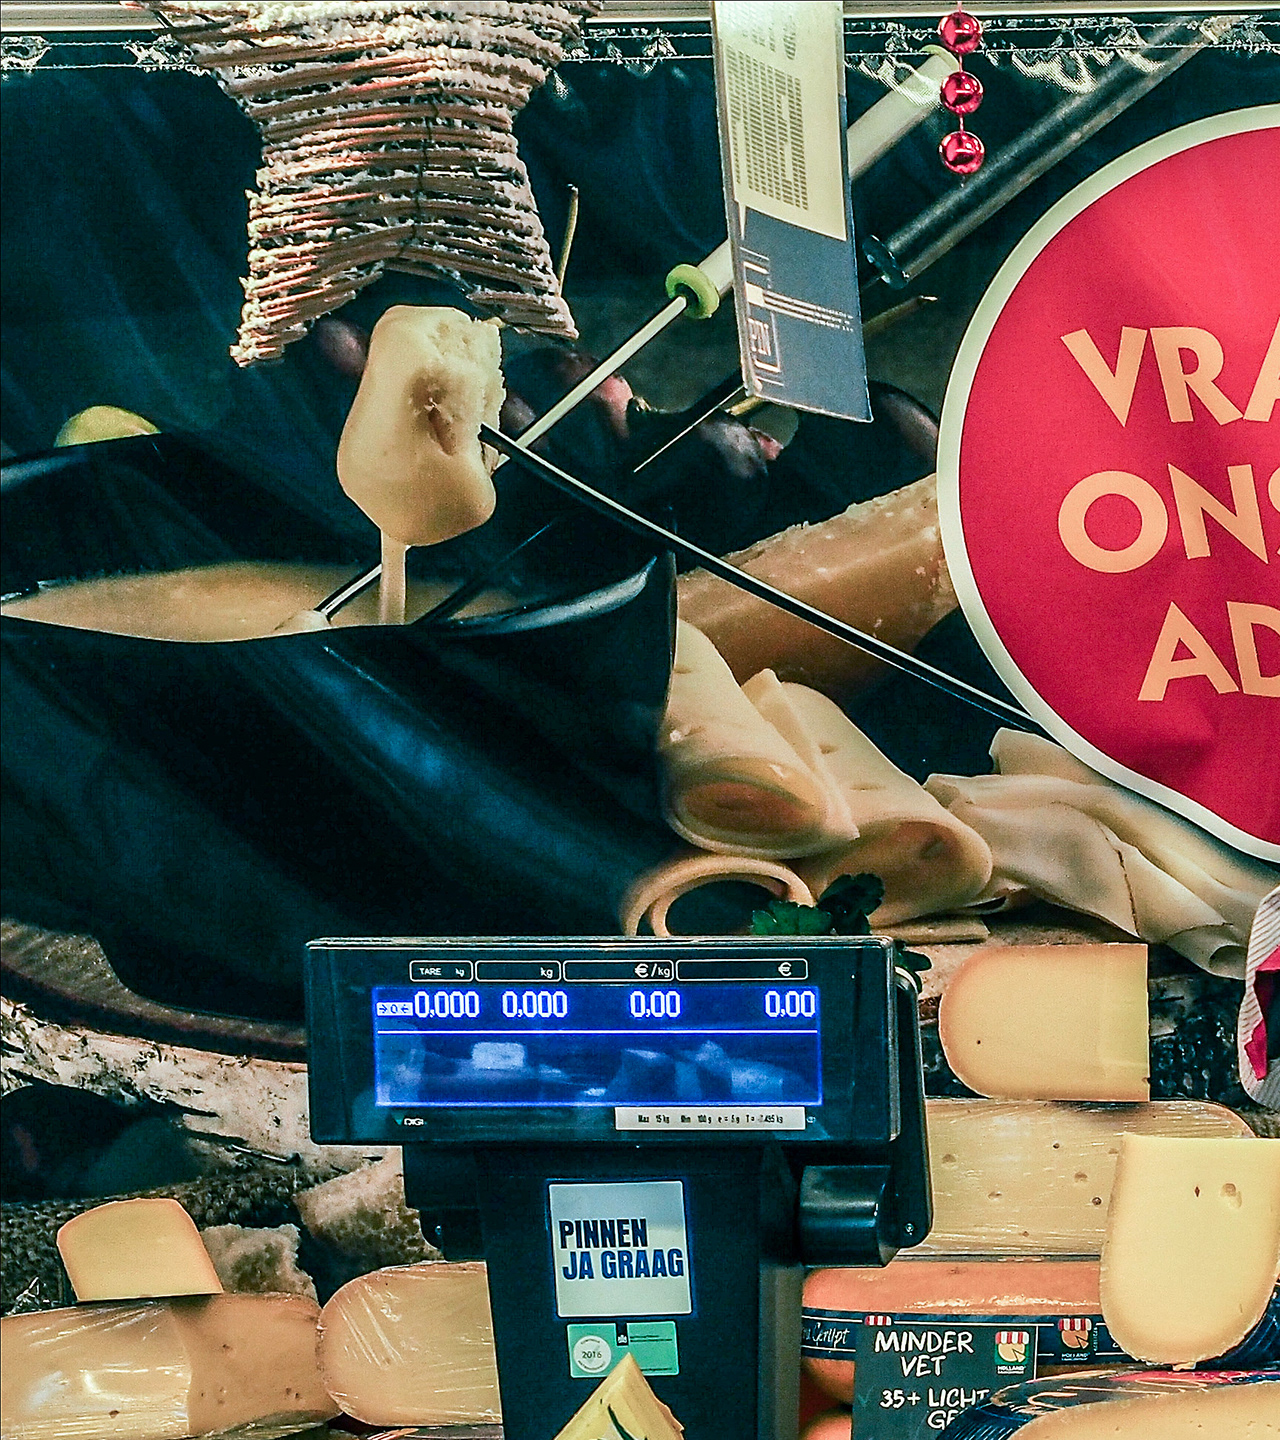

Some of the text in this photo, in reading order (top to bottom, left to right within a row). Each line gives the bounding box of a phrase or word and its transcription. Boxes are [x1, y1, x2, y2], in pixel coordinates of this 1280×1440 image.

[419, 967, 442, 976] TARE
[540, 966, 553, 979] kg
[777, 962, 792, 977] €
[414, 990, 480, 1019] 0,000
[502, 990, 568, 1019] 0,000
[630, 990, 681, 1019] 0,00
[765, 990, 816, 1019] 0,00
[559, 1218, 648, 1249] PINNEN
[562, 1249, 685, 1280] JA GRAAG
[874, 1331, 974, 1354] MINDER
[582, 1350, 602, 1359] 2016
[900, 1355, 946, 1377] VET
[879, 1387, 991, 1409] 35+ LICHT
